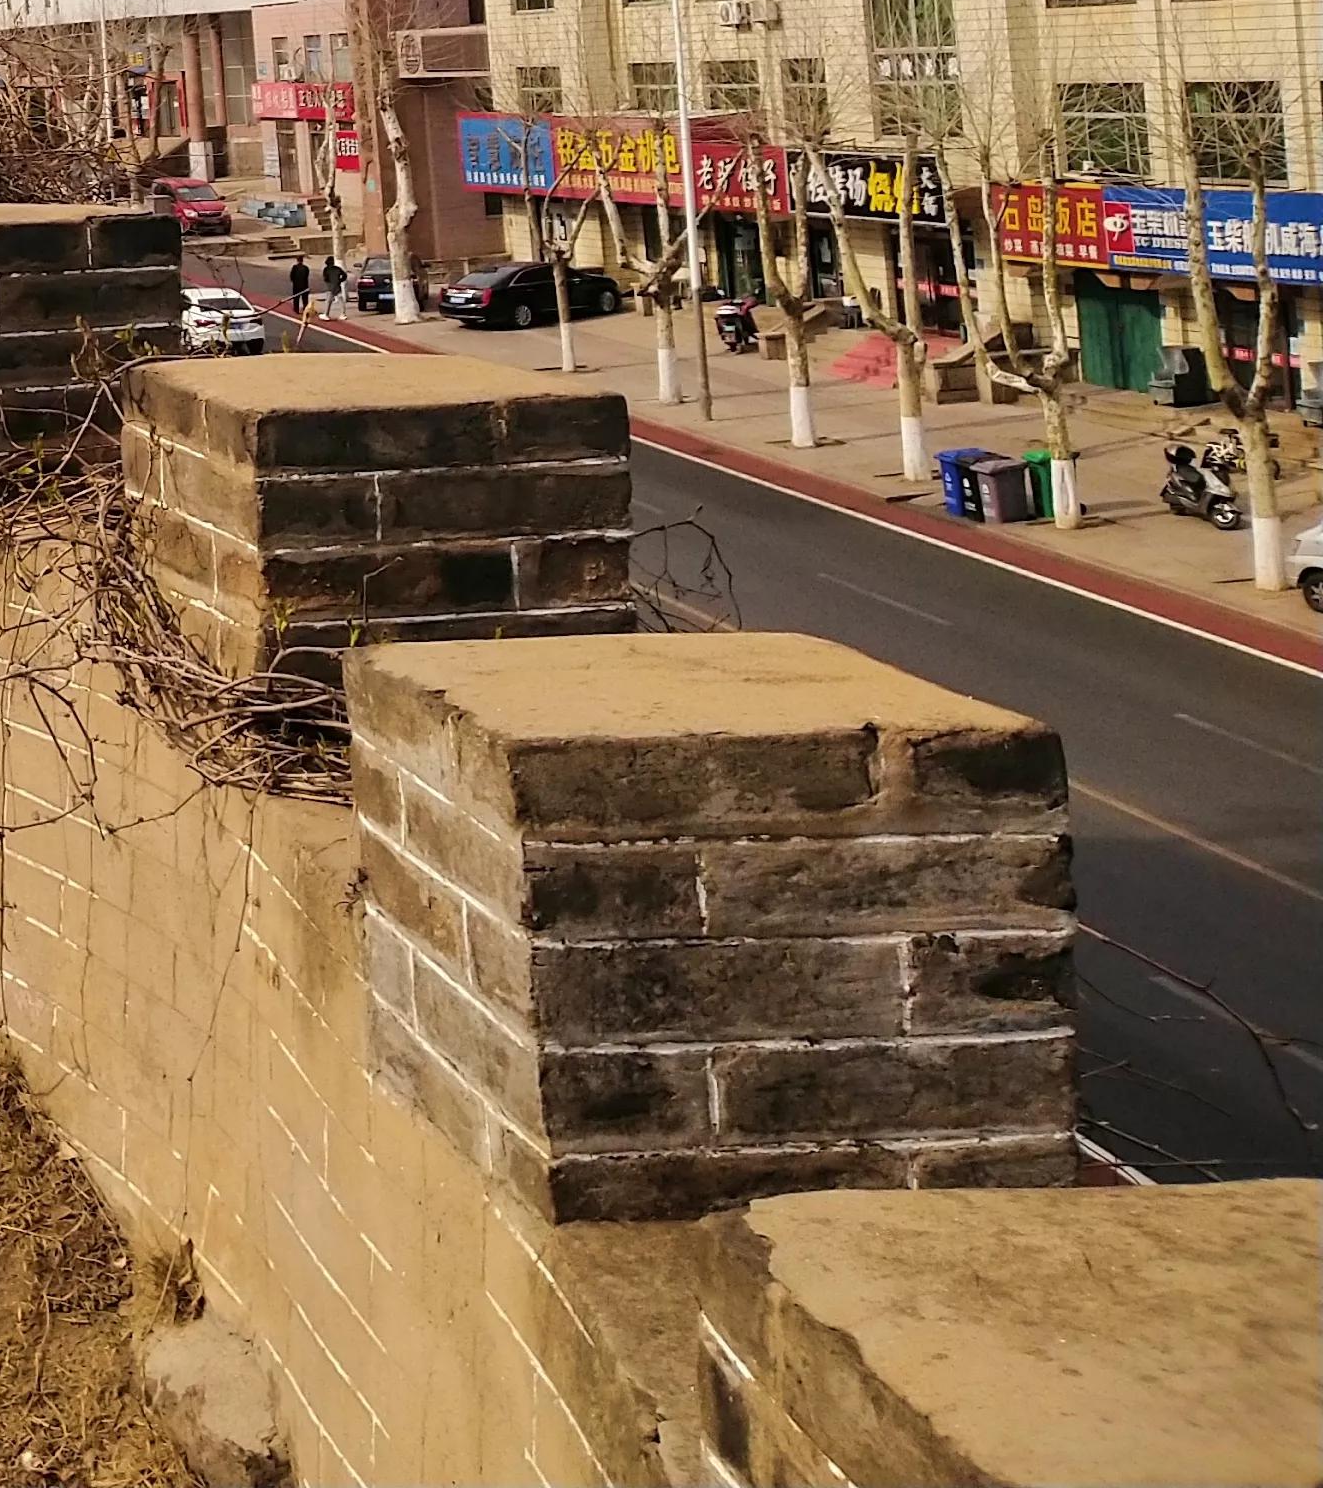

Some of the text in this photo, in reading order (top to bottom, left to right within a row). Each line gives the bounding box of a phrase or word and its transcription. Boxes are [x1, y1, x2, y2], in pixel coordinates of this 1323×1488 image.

[1206, 218, 1323, 259] 玉柴机威海
